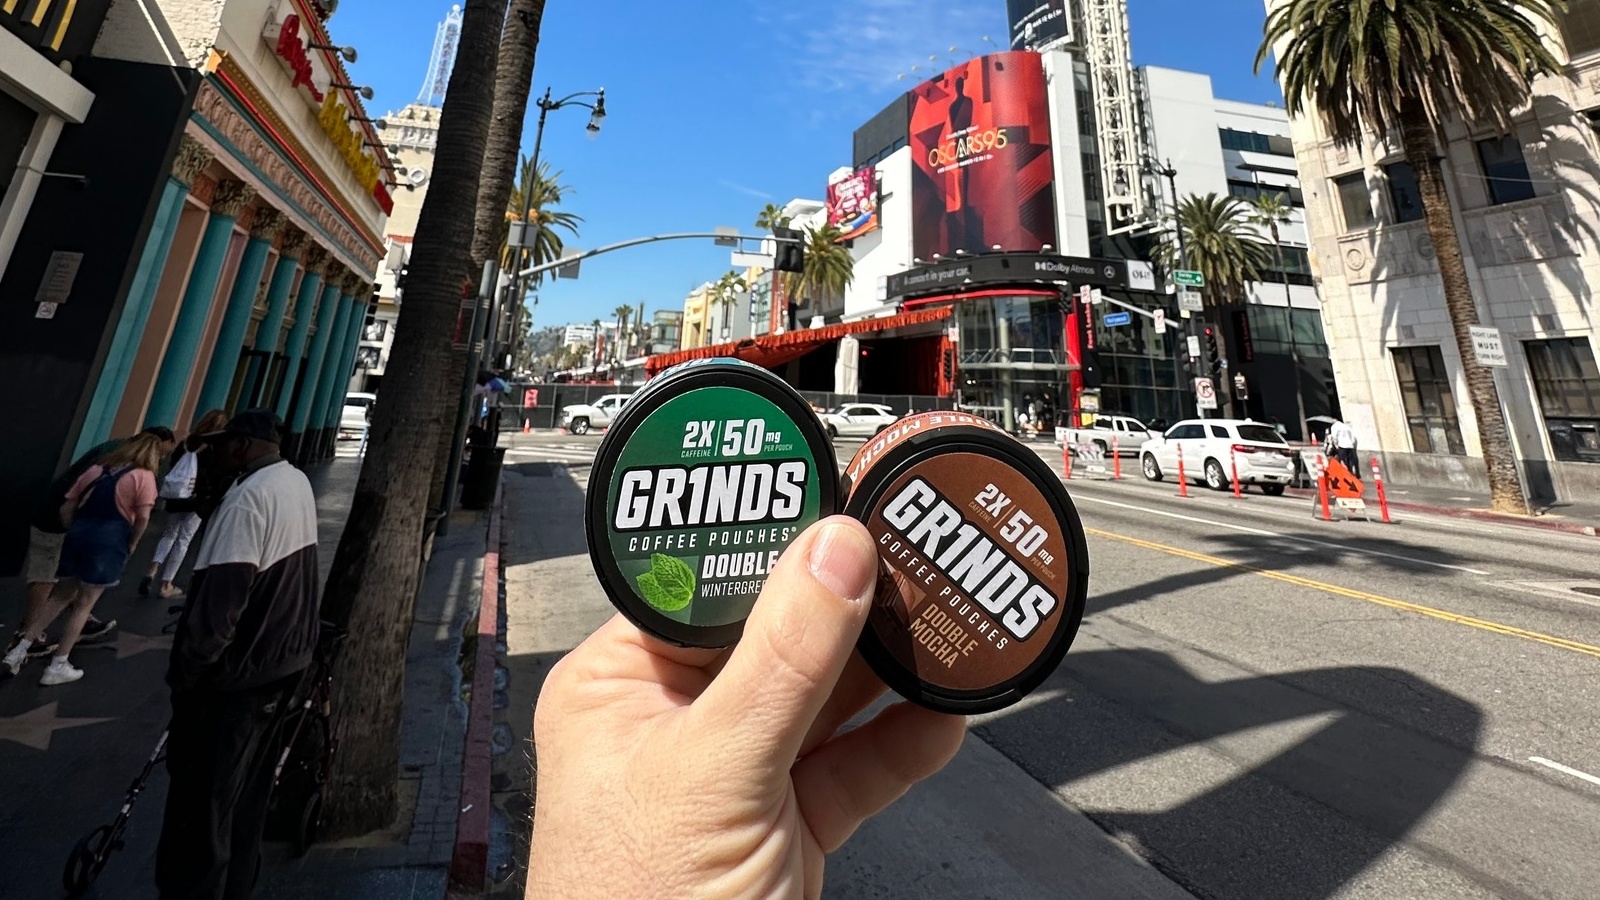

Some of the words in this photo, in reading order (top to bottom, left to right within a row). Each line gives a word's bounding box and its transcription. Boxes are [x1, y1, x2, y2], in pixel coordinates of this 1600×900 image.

[938, 269, 955, 282] your
[1046, 261, 1070, 274] Dolby
[1070, 264, 1095, 275] Atmos
[1084, 303, 1092, 328] Locke
[1477, 342, 1498, 350] MUST
[682, 420, 716, 448] 2X
[722, 418, 765, 457] 50
[765, 432, 781, 443] mg
[764, 444, 775, 452] PER
[775, 443, 793, 451] POUCH
[681, 449, 712, 458] CAFFEINE
[615, 462, 806, 529] GR1NDS
[968, 501, 992, 523] CAFFEINE
[974, 483, 1012, 518] 2X
[999, 509, 1049, 558] 50
[1037, 549, 1054, 565] mg
[629, 533, 697, 551] COFFEE
[701, 550, 779, 579] DOUBLE
[882, 479, 1056, 638] GR1NDS
[1031, 556, 1041, 567] PER
[1040, 564, 1056, 580] POUCH
[880, 532, 937, 585] COFFEE
[939, 586, 1008, 650] POUCHES
[921, 603, 979, 657] DOUBLE
[910, 617, 959, 669] MOCHA
